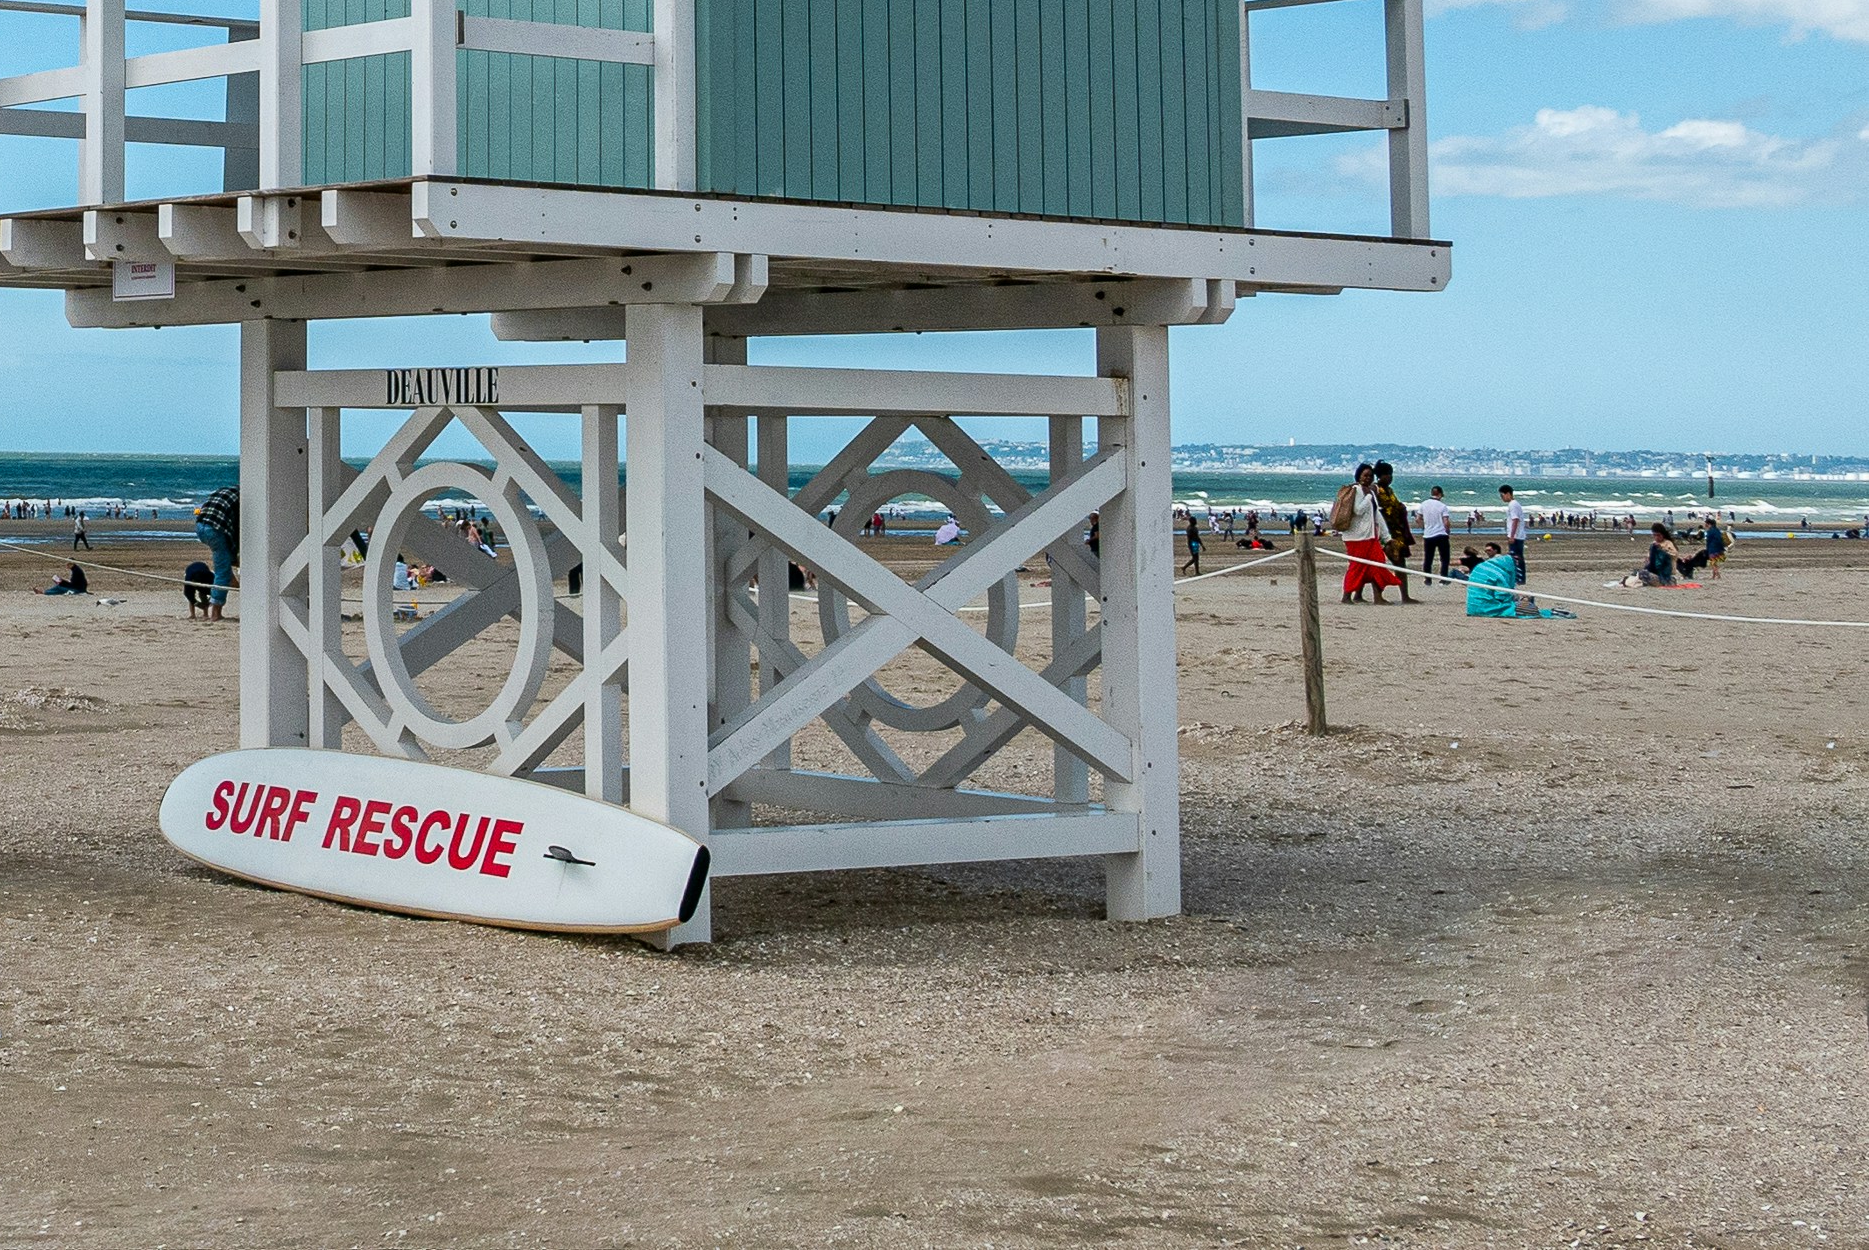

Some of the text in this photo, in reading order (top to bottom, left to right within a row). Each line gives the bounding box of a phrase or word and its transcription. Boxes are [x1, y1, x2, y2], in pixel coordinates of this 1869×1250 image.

[386, 367, 499, 405] DEAUVILLE
[205, 780, 525, 879] SURF RESCUE
